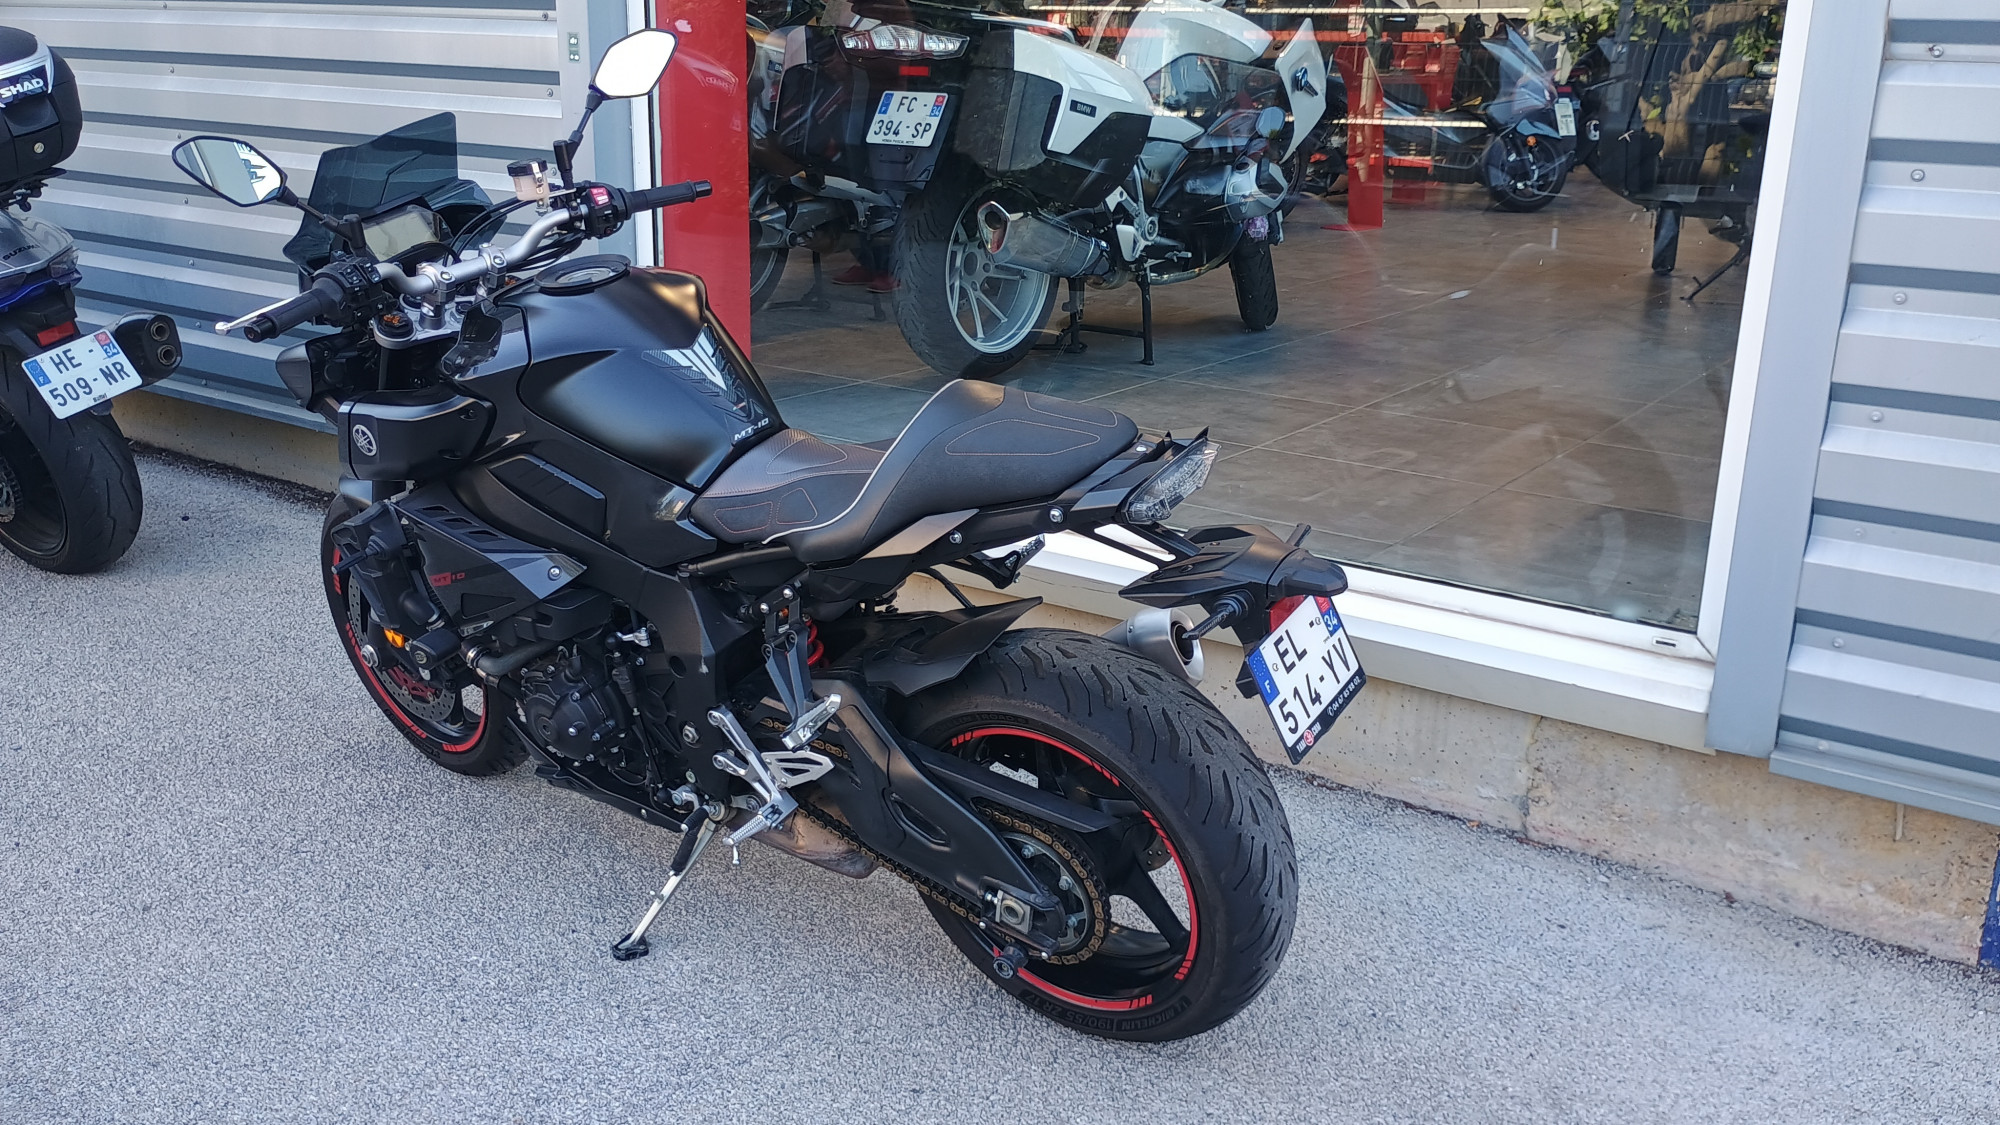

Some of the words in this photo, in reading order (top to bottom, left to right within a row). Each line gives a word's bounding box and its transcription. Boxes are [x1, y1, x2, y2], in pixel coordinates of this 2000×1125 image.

[0, 78, 44, 98] SHAD
[896, 96, 918, 113] FC
[931, 106, 941, 116] 34
[1076, 103, 1092, 114] BMW
[873, 119, 932, 139] 394-SP
[103, 345, 118, 356] 34
[49, 348, 82, 374] HE
[49, 361, 131, 407] 509-NR
[734, 418, 769, 440] MT-10
[1323, 609, 1338, 631] 34
[1273, 629, 1308, 674] EL
[1264, 679, 1271, 694] F
[1278, 637, 1351, 735] 514-YV
[1043, 1001, 1061, 1017] ZR
[1066, 1011, 1112, 1030] 190/55
[1120, 1009, 1176, 1031] MICHELIN
